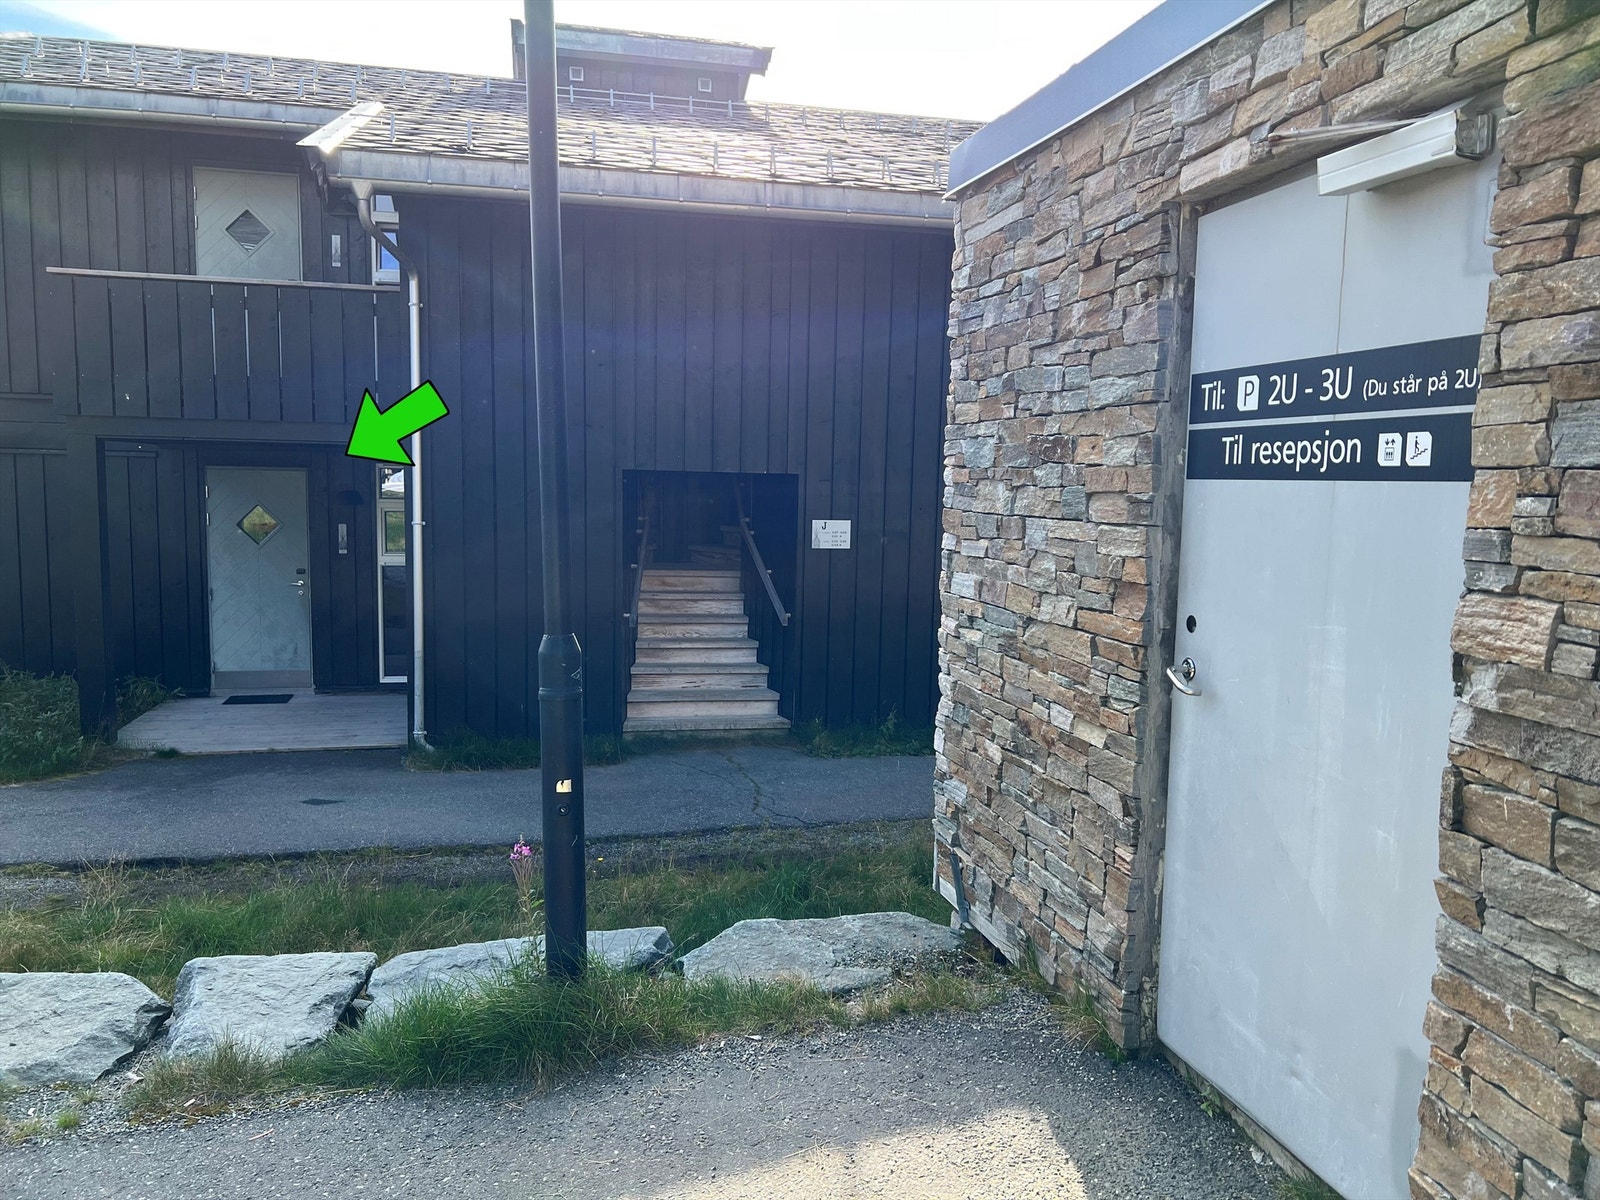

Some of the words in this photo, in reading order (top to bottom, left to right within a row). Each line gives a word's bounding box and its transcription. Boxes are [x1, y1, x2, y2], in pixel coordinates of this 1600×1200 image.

[1201, 381, 1226, 411] Til:
[1268, 373, 1298, 406] 2U
[1319, 366, 1353, 401] 3U
[1362, 378, 1388, 401] (Du
[1392, 375, 1423, 394] står
[1427, 370, 1448, 397] på
[1222, 434, 1243, 465] Til
[1251, 430, 1362, 472] resepsjon
[821, 522, 827, 530] J
